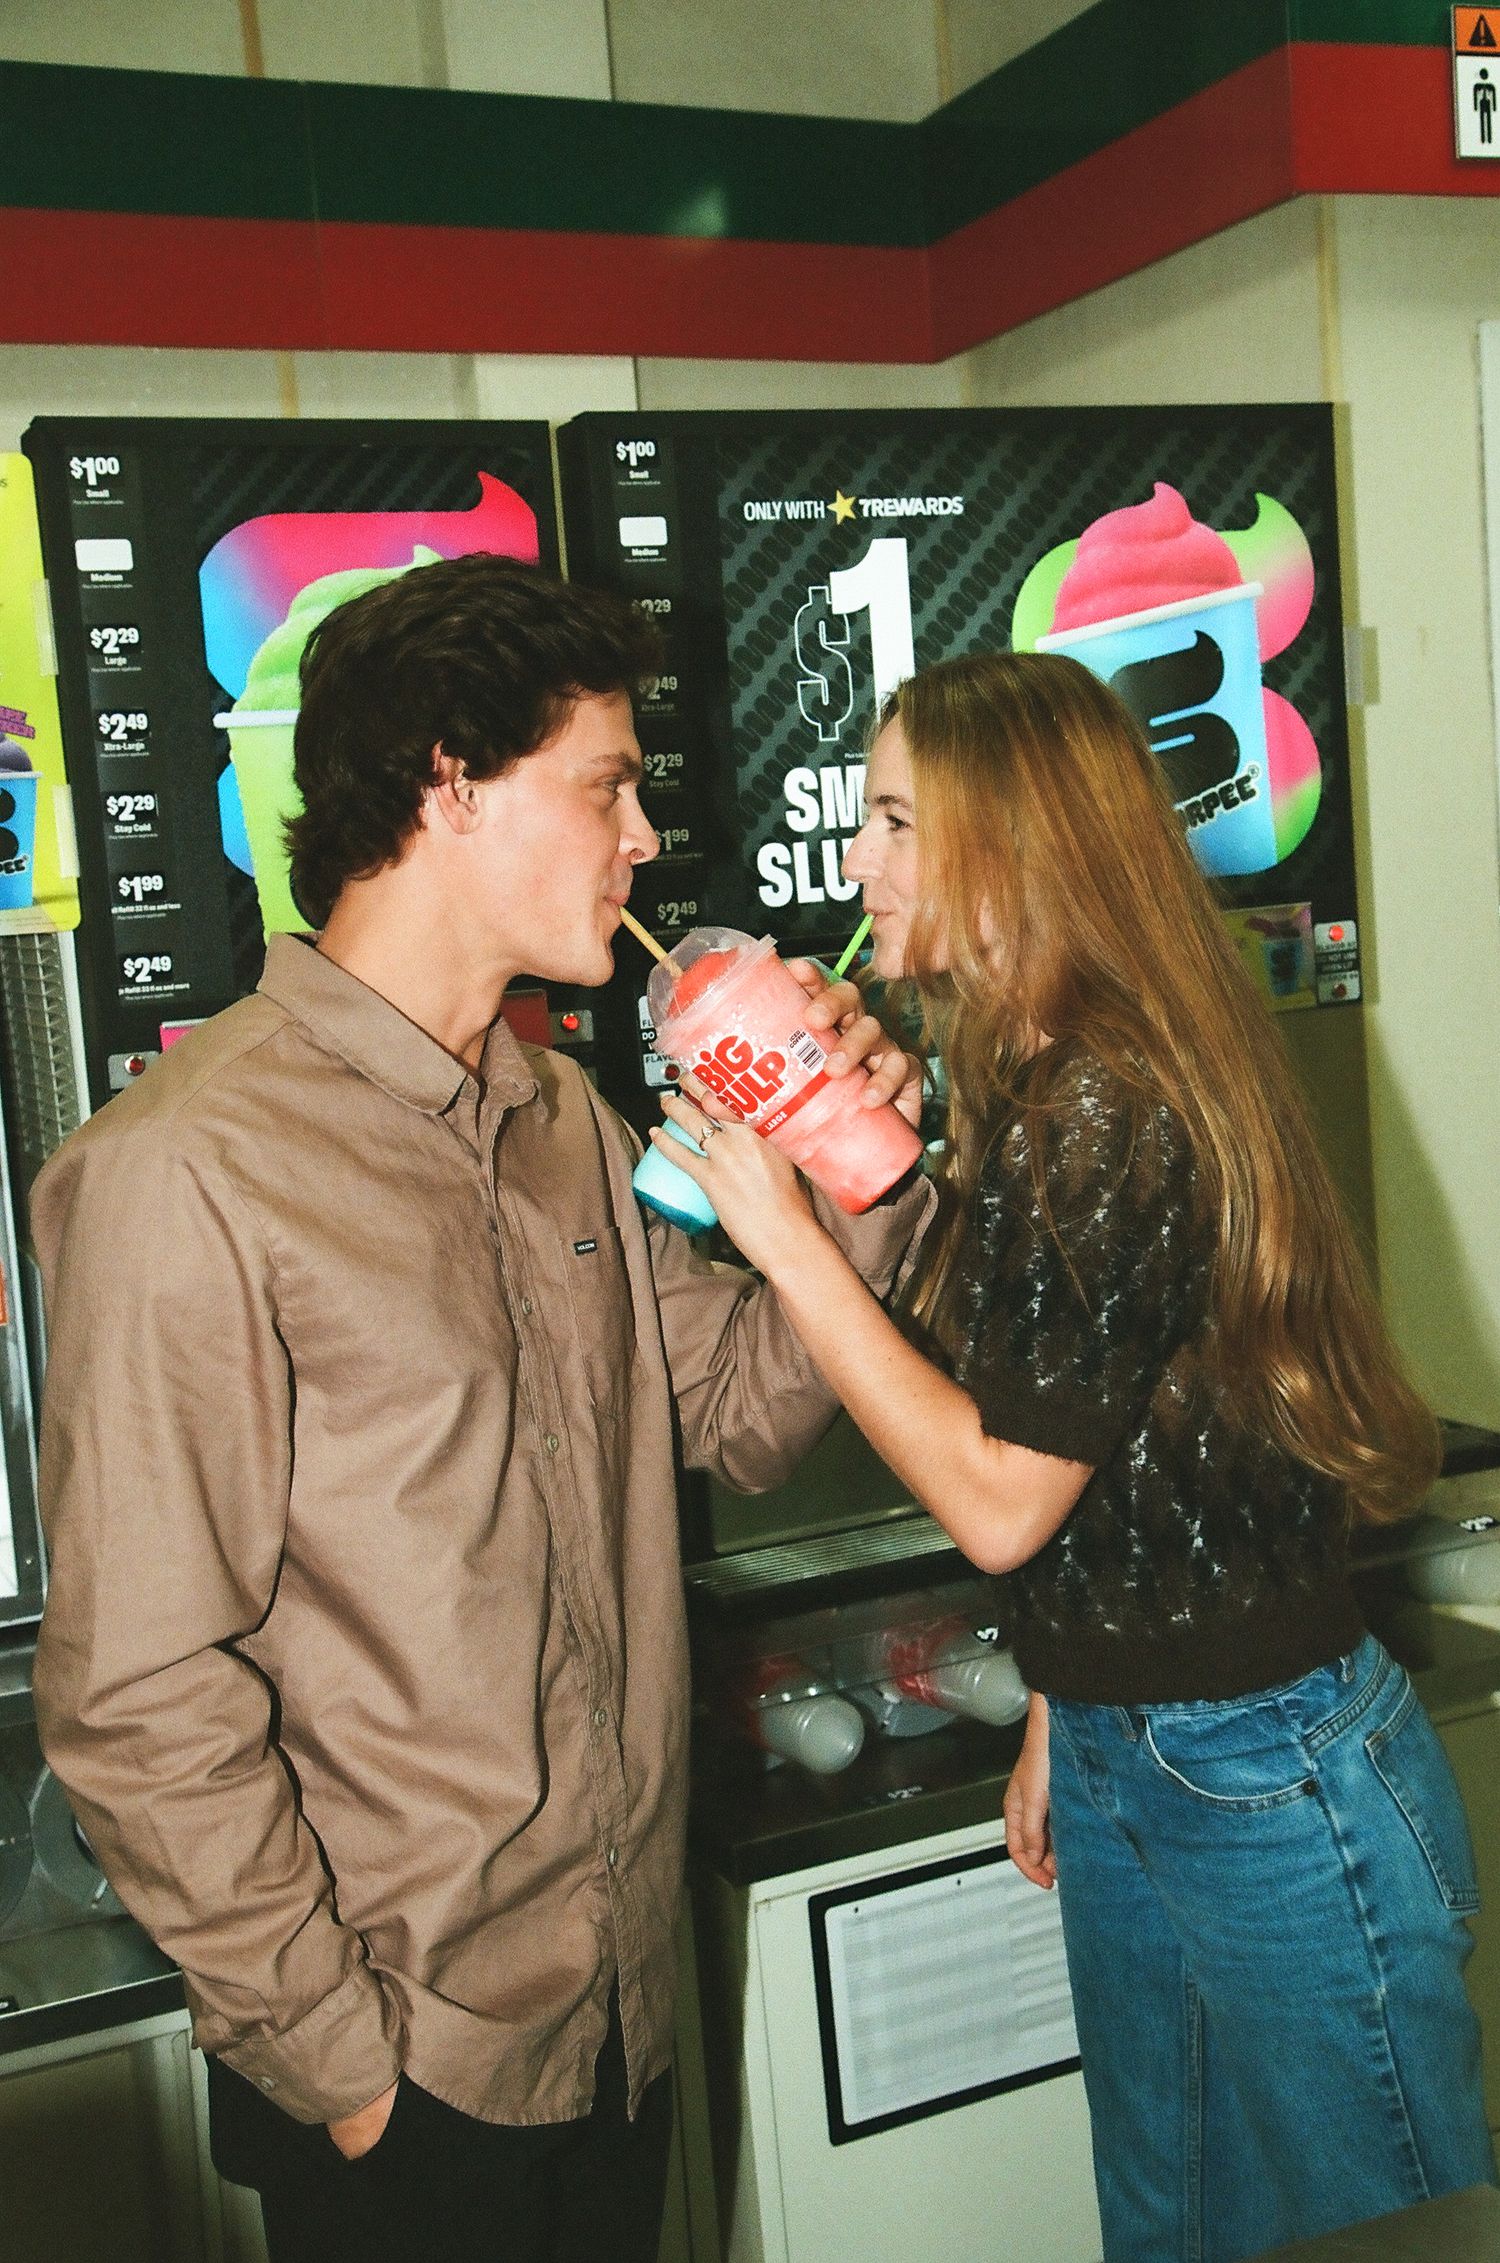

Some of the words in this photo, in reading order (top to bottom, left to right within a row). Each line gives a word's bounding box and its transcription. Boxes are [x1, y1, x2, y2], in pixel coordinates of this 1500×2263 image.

[743, 501, 782, 521] ONLY
[784, 500, 825, 520] WITH
[859, 496, 964, 517] 7REWARDS
[794, 538, 915, 741] $1
[104, 656, 127, 666] Large
[1178, 774, 1257, 828] RPEE
[114, 824, 133, 834] Stay
[133, 823, 152, 832] Cold
[765, 1111, 788, 1131] LARGE
